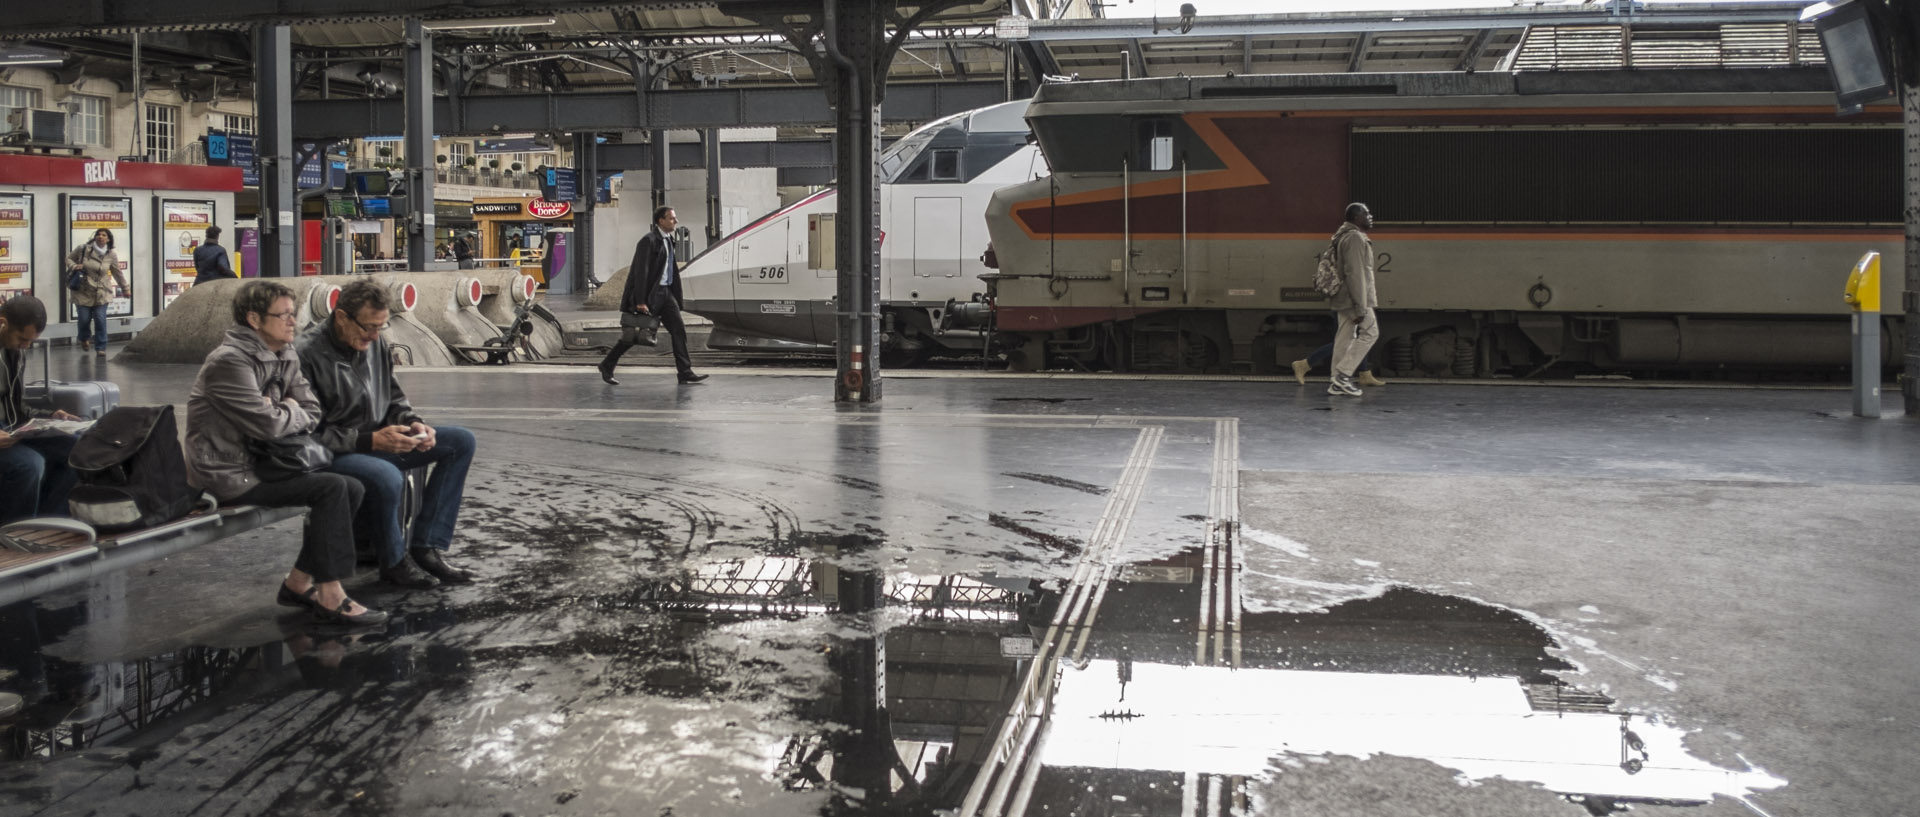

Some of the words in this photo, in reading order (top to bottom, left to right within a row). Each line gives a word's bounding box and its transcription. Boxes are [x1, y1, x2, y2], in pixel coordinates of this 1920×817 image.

[211, 141, 225, 155] 26
[84, 161, 116, 184] RELAY
[537, 207, 561, 216] Dorée
[759, 267, 785, 279] 506
